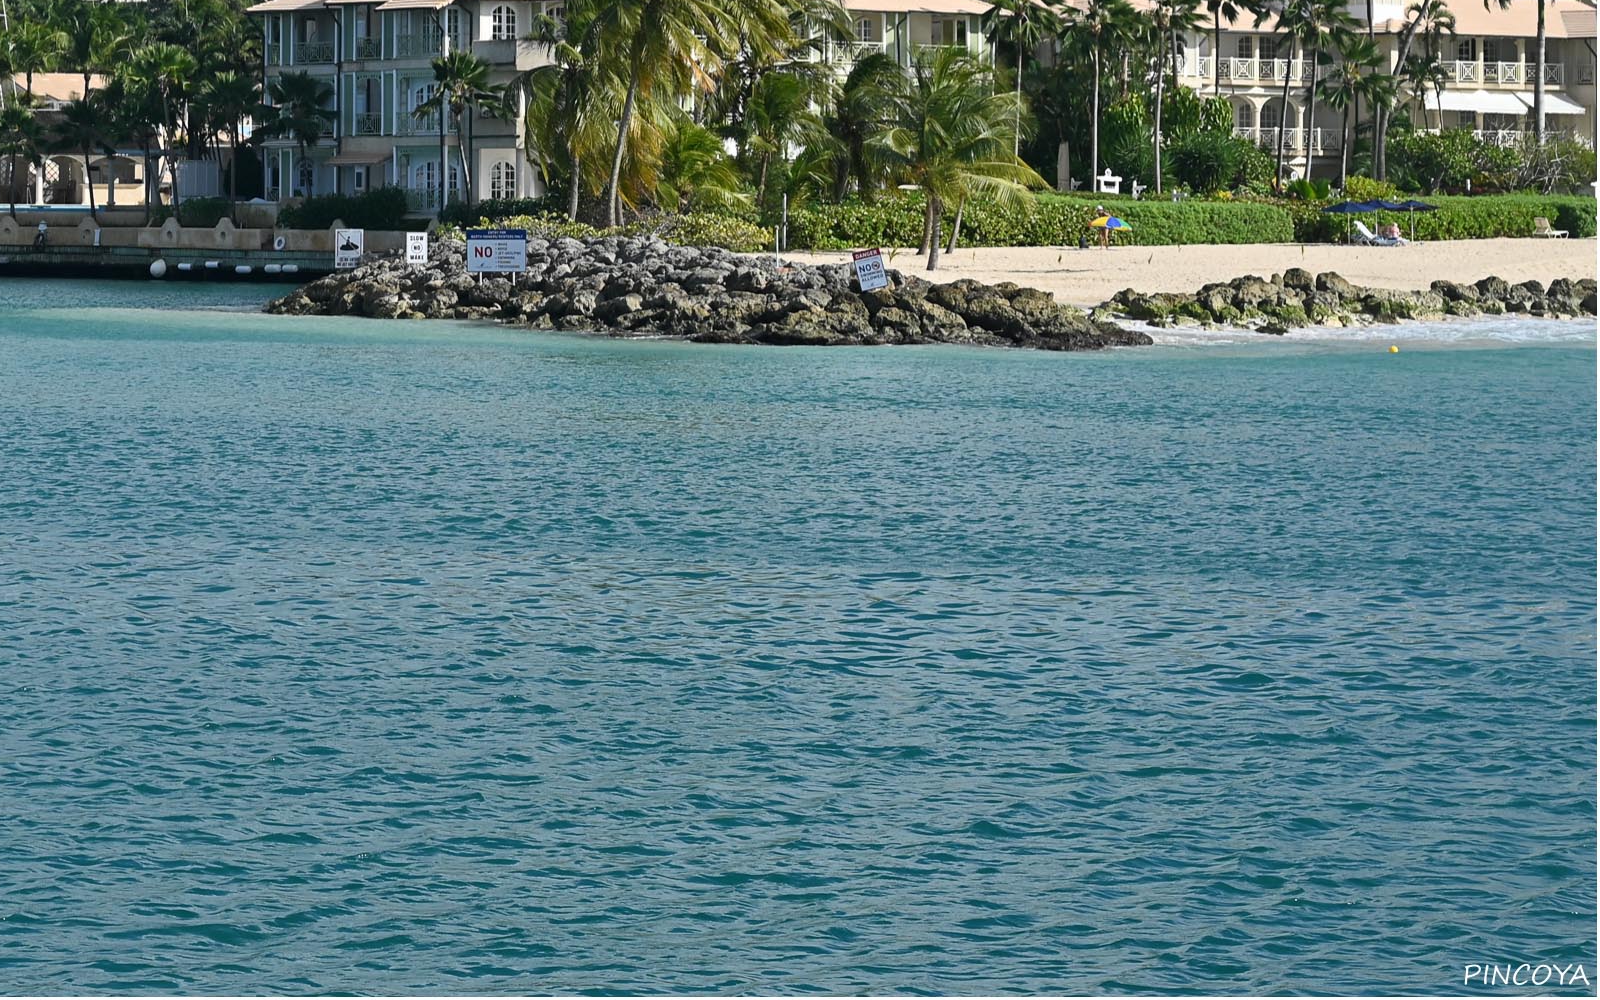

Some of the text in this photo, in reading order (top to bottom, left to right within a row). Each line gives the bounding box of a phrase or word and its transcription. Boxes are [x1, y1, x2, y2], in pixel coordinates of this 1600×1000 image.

[474, 246, 493, 258] NO
[855, 251, 878, 259] DANGER
[859, 264, 871, 273] NO
